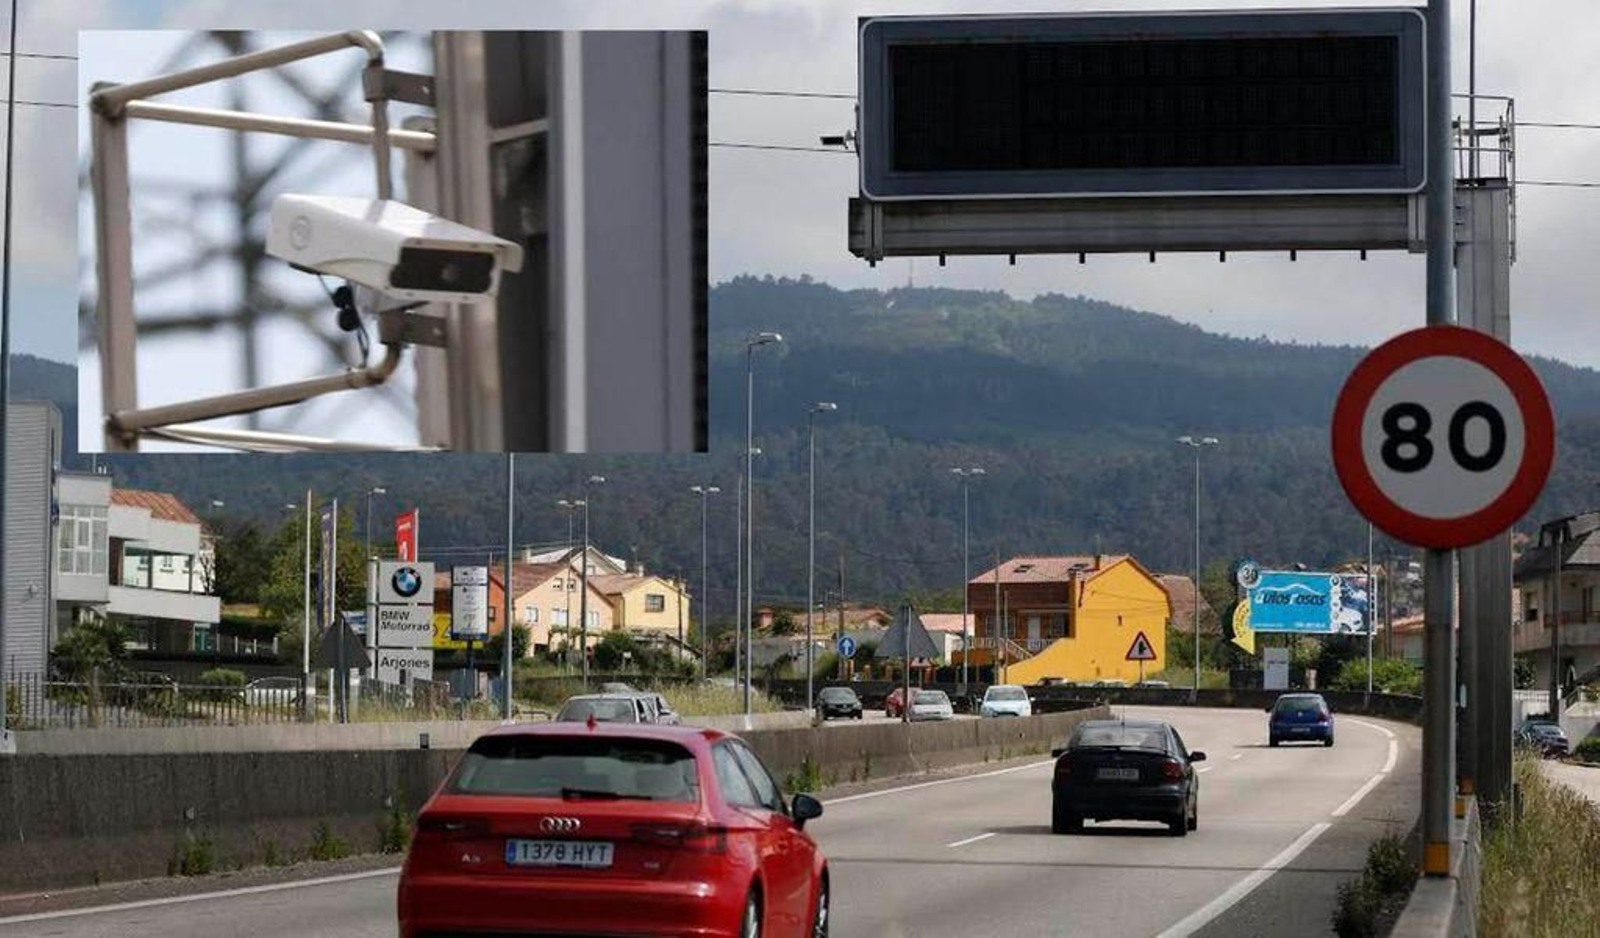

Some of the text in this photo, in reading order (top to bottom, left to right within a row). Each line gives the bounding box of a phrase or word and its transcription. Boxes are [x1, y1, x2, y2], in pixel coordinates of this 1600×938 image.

[1380, 400, 1507, 473] 80
[380, 610, 410, 622] BMW
[380, 620, 430, 632] Motorrad
[380, 657, 430, 670] Arjones
[522, 843, 607, 863] 1378 HYT
